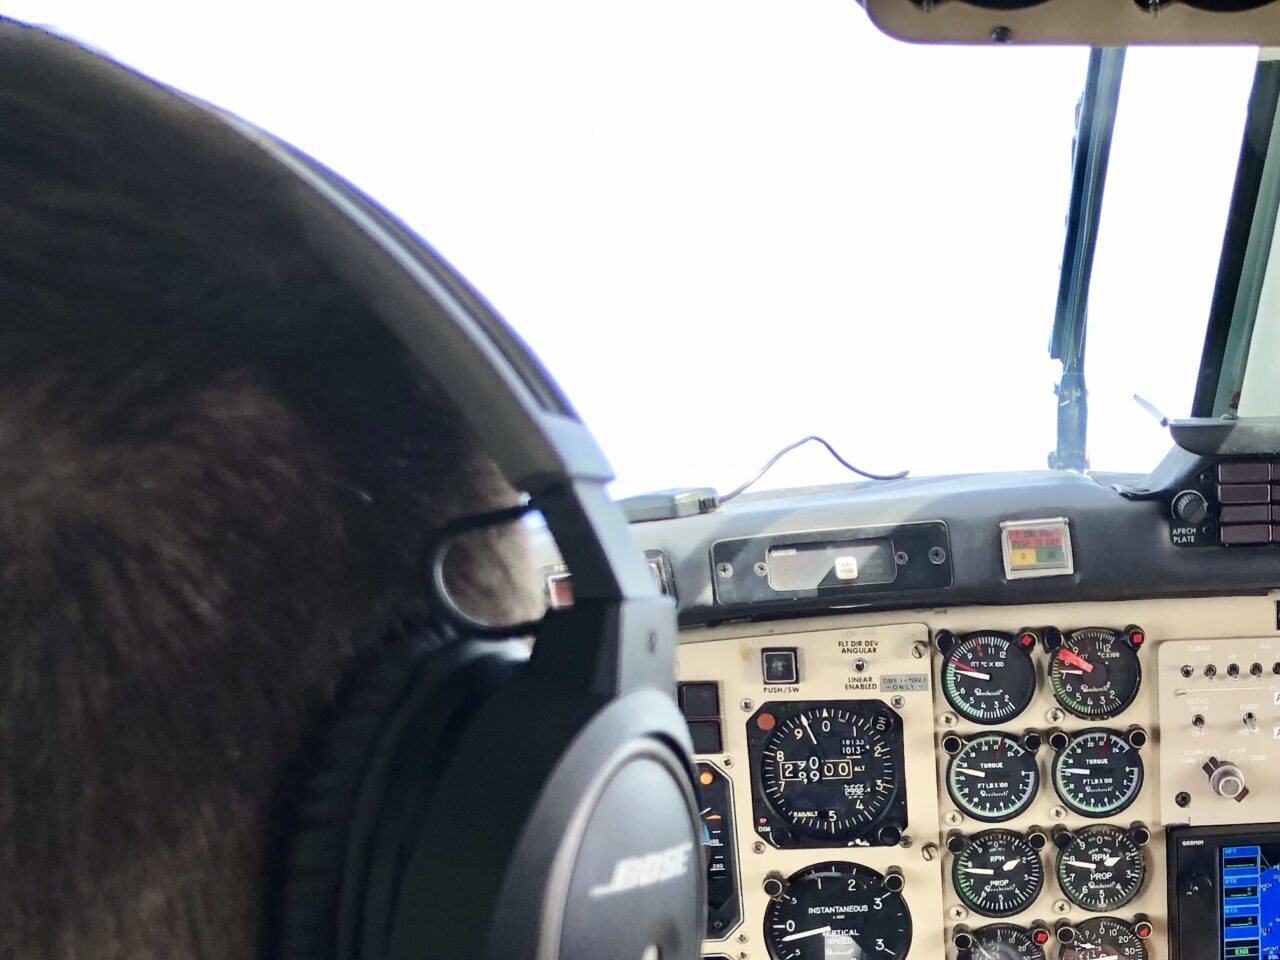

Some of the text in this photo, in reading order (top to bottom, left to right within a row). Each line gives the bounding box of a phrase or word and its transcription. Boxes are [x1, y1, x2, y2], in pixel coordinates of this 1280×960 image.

[1172, 527, 1197, 535] APRCH
[1173, 535, 1195, 543] PLATE
[763, 686, 800, 694] PUSH/SW
[845, 683, 877, 691] ENABLED
[990, 855, 1005, 863] RPM
[1091, 853, 1110, 861] RPM
[1090, 872, 1113, 880] PROP
[808, 904, 868, 914] INSTANTANEOUS
[827, 937, 853, 945] SPEED
[1235, 947, 1249, 956] ENR
